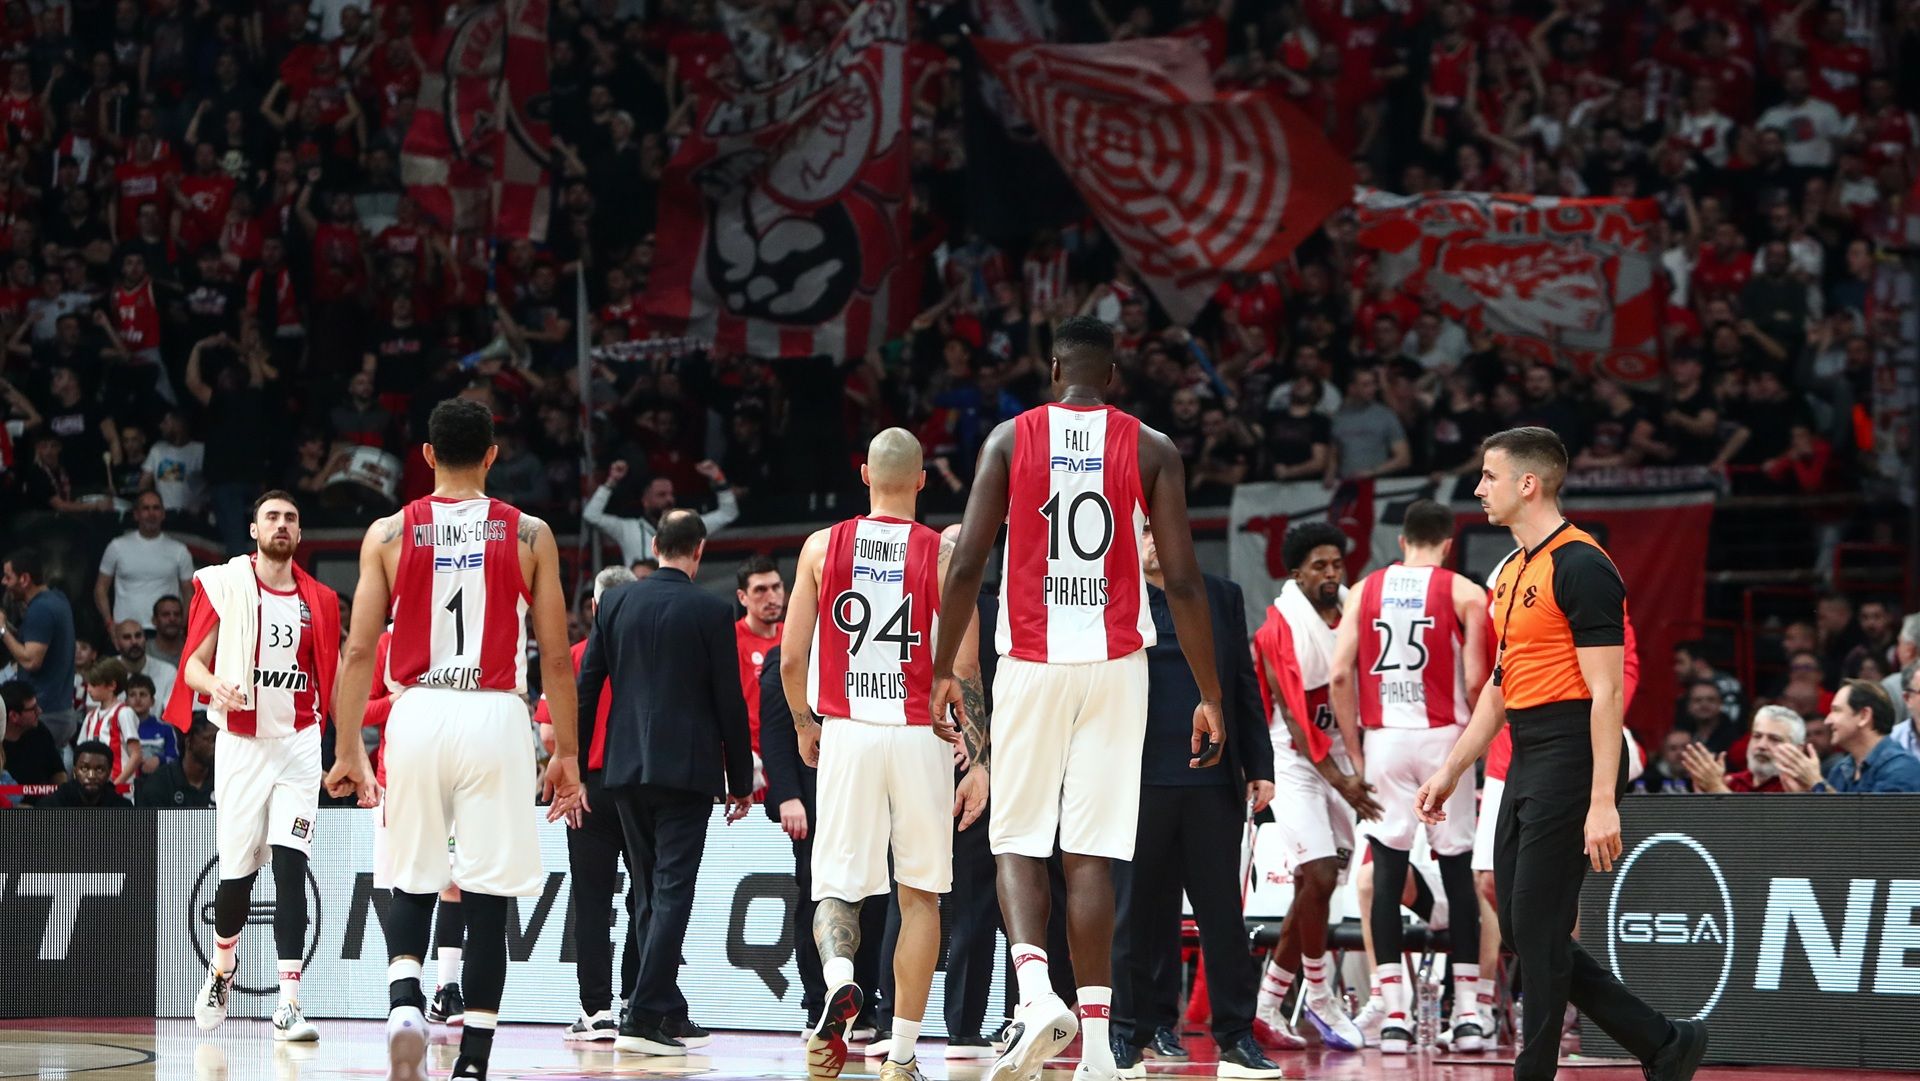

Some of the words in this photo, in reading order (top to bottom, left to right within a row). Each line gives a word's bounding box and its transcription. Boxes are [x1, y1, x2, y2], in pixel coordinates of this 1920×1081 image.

[1065, 428, 1091, 452] FALL
[1051, 456, 1102, 472] FMS
[412, 519, 507, 548] WILLIAMS-GOSS
[1040, 491, 1114, 562] 10
[434, 552, 484, 571] FMS
[854, 537, 906, 562] FOURNIER
[853, 565, 904, 582] FMS
[1043, 576, 1109, 606] PIRAEUS
[445, 586, 465, 656] 1
[833, 591, 920, 661] 94
[268, 623, 293, 648] 33
[1372, 618, 1434, 673] 25
[845, 672, 908, 699] PIRAEUS
[1379, 680, 1427, 704] PIRAEUS
[1618, 912, 1723, 944] GSA
